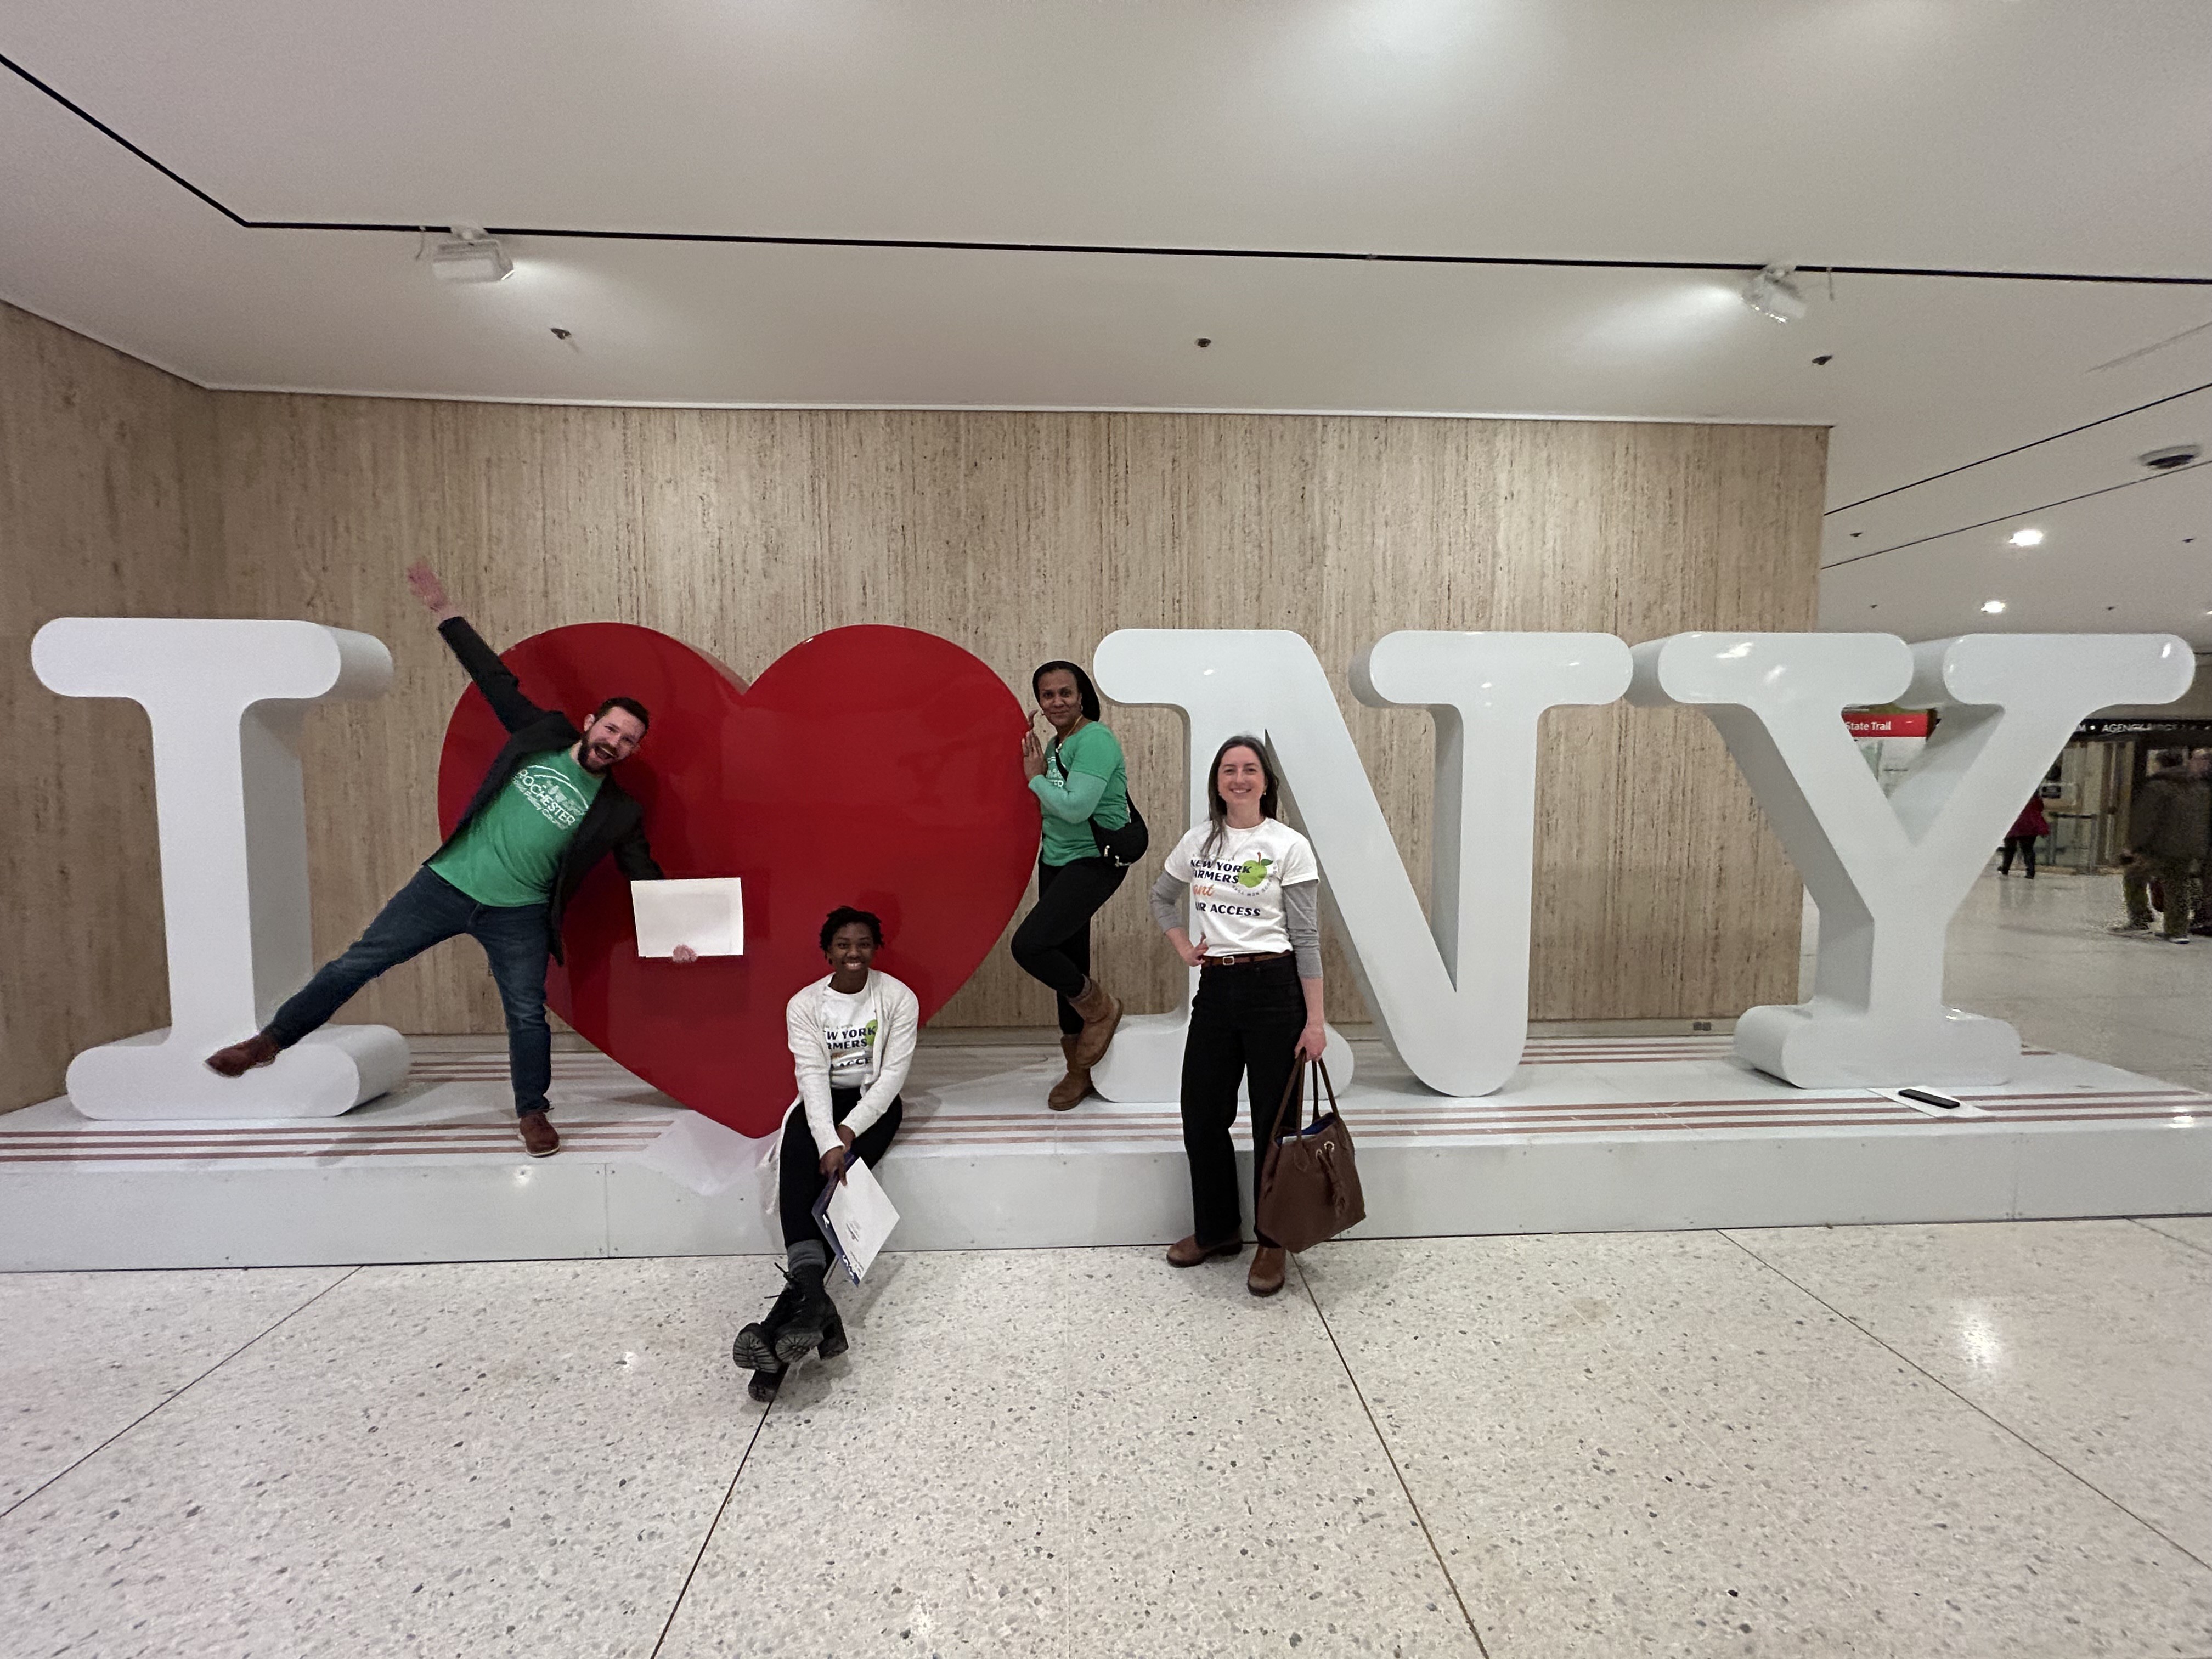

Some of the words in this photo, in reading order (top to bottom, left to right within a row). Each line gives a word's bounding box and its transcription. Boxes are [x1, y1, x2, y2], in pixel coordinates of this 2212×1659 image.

[1846, 721, 1869, 730] State
[1871, 721, 1891, 730] Trail
[31, 617, 392, 1120] I
[1217, 861, 1252, 873] YORK
[1195, 870, 1240, 884] ARMERS
[1193, 884, 1214, 896] ant
[1210, 904, 1261, 916] ACCESS
[842, 1026, 876, 1039] YORK
[827, 1038, 867, 1050] RMERS
